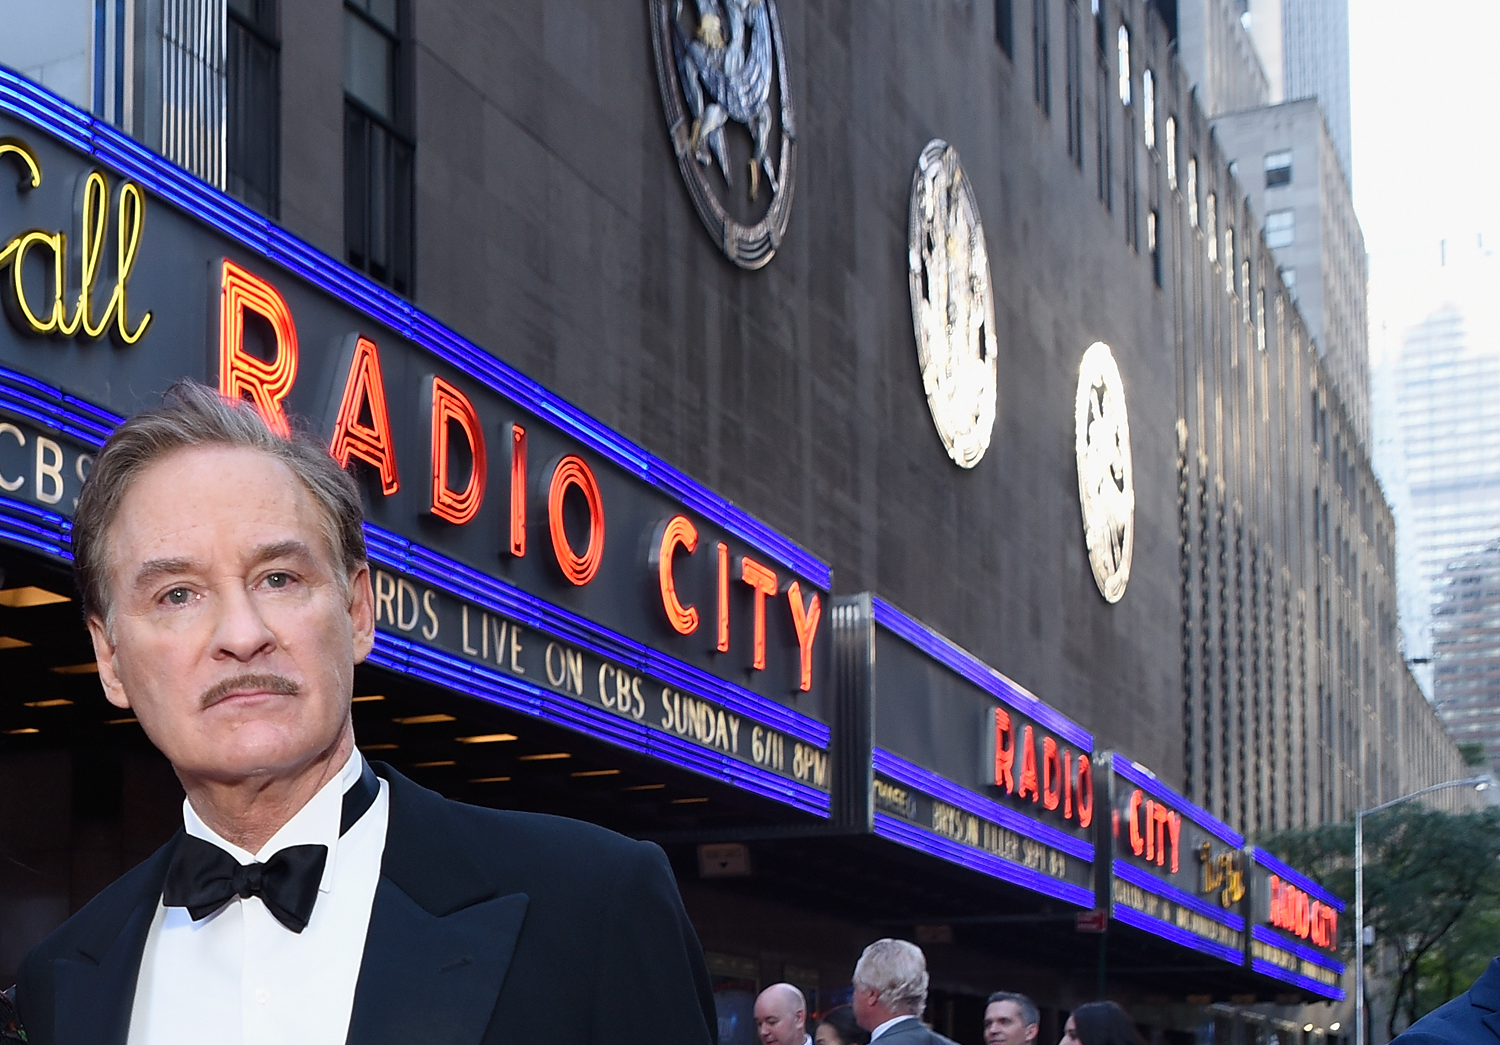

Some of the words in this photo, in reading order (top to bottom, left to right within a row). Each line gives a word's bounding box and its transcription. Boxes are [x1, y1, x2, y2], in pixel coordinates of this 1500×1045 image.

[219, 257, 605, 587] RADIO
[658, 513, 822, 693] CITY
[376, 570, 440, 641] RDS
[462, 604, 526, 675] LIVE
[545, 641, 584, 696] ON
[599, 662, 646, 720] CBS
[661, 687, 741, 754] SUNDAY
[752, 725, 785, 772] 6/11
[793, 742, 828, 786] 8PM
[995, 707, 1093, 828] RADIO
[1129, 788, 1182, 874] CITY
